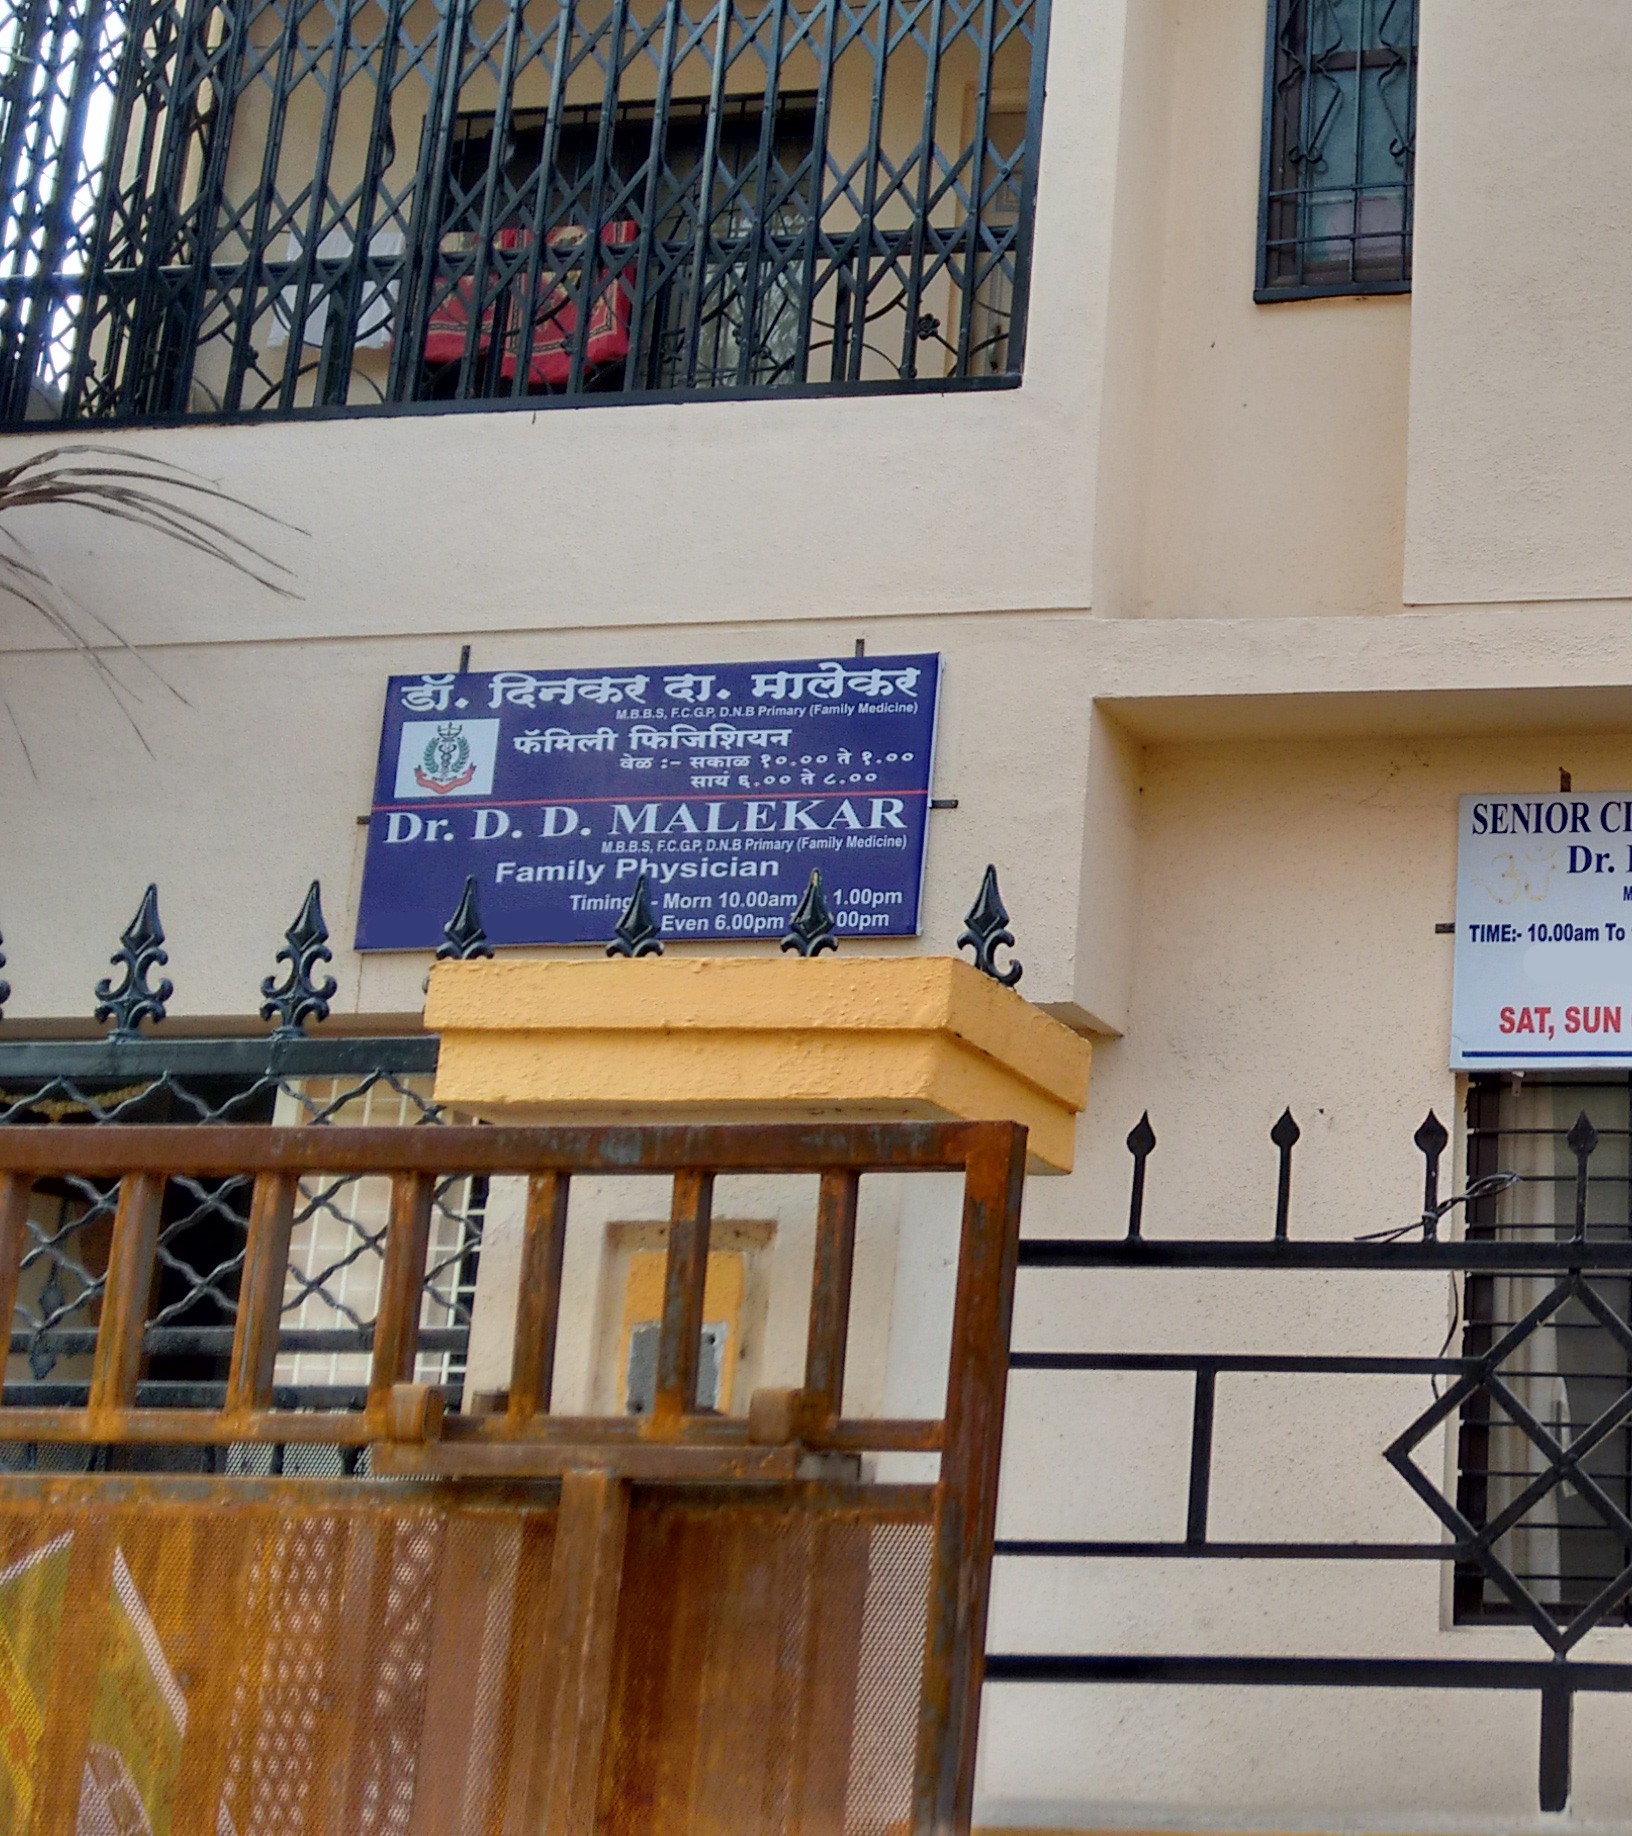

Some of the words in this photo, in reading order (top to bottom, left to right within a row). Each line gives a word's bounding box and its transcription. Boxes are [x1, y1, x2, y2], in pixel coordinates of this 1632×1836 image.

[401, 673, 470, 711] डॉ.
[488, 671, 650, 709] दिनकर
[663, 672, 731, 703] दा.
[751, 662, 921, 699] मालेकर
[616, 707, 668, 721] M.B.B.S,
[720, 706, 755, 717] D.N.B
[758, 704, 805, 719] Primary
[809, 702, 855, 717] (Family
[858, 701, 919, 715] Medicine)
[628, 722, 793, 751] फिजिशियन
[619, 754, 654, 770] वेळ
[690, 754, 751, 769] सकाळ
[836, 747, 853, 766] ते
[800, 768, 816, 786] ते
[384, 811, 455, 844] Dr.
[470, 808, 523, 841] D.
[539, 805, 592, 838] D.
[608, 797, 909, 836] MALEKAR
[1472, 801, 1592, 835] SENIOR
[601, 837, 653, 855] M.B.B.S,
[705, 835, 741, 852] D.N.B
[744, 834, 794, 853] Primary
[796, 834, 844, 853] (Family
[846, 832, 908, 851] Medicine)
[495, 860, 605, 886] Family
[615, 856, 780, 885] Physician
[1566, 844, 1615, 874] Dr.
[663, 892, 712, 910] Morn
[718, 890, 798, 910] 10.00am
[833, 888, 903, 908] 1.00pm
[660, 914, 709, 932] Even
[714, 912, 785, 934] 6.00pm
[1469, 922, 1522, 943] TIME:-
[1528, 922, 1599, 943] 10.00am
[1605, 922, 1625, 941] To
[1499, 1006, 1555, 1041] SAT,
[1565, 1005, 1622, 1034] SUN
